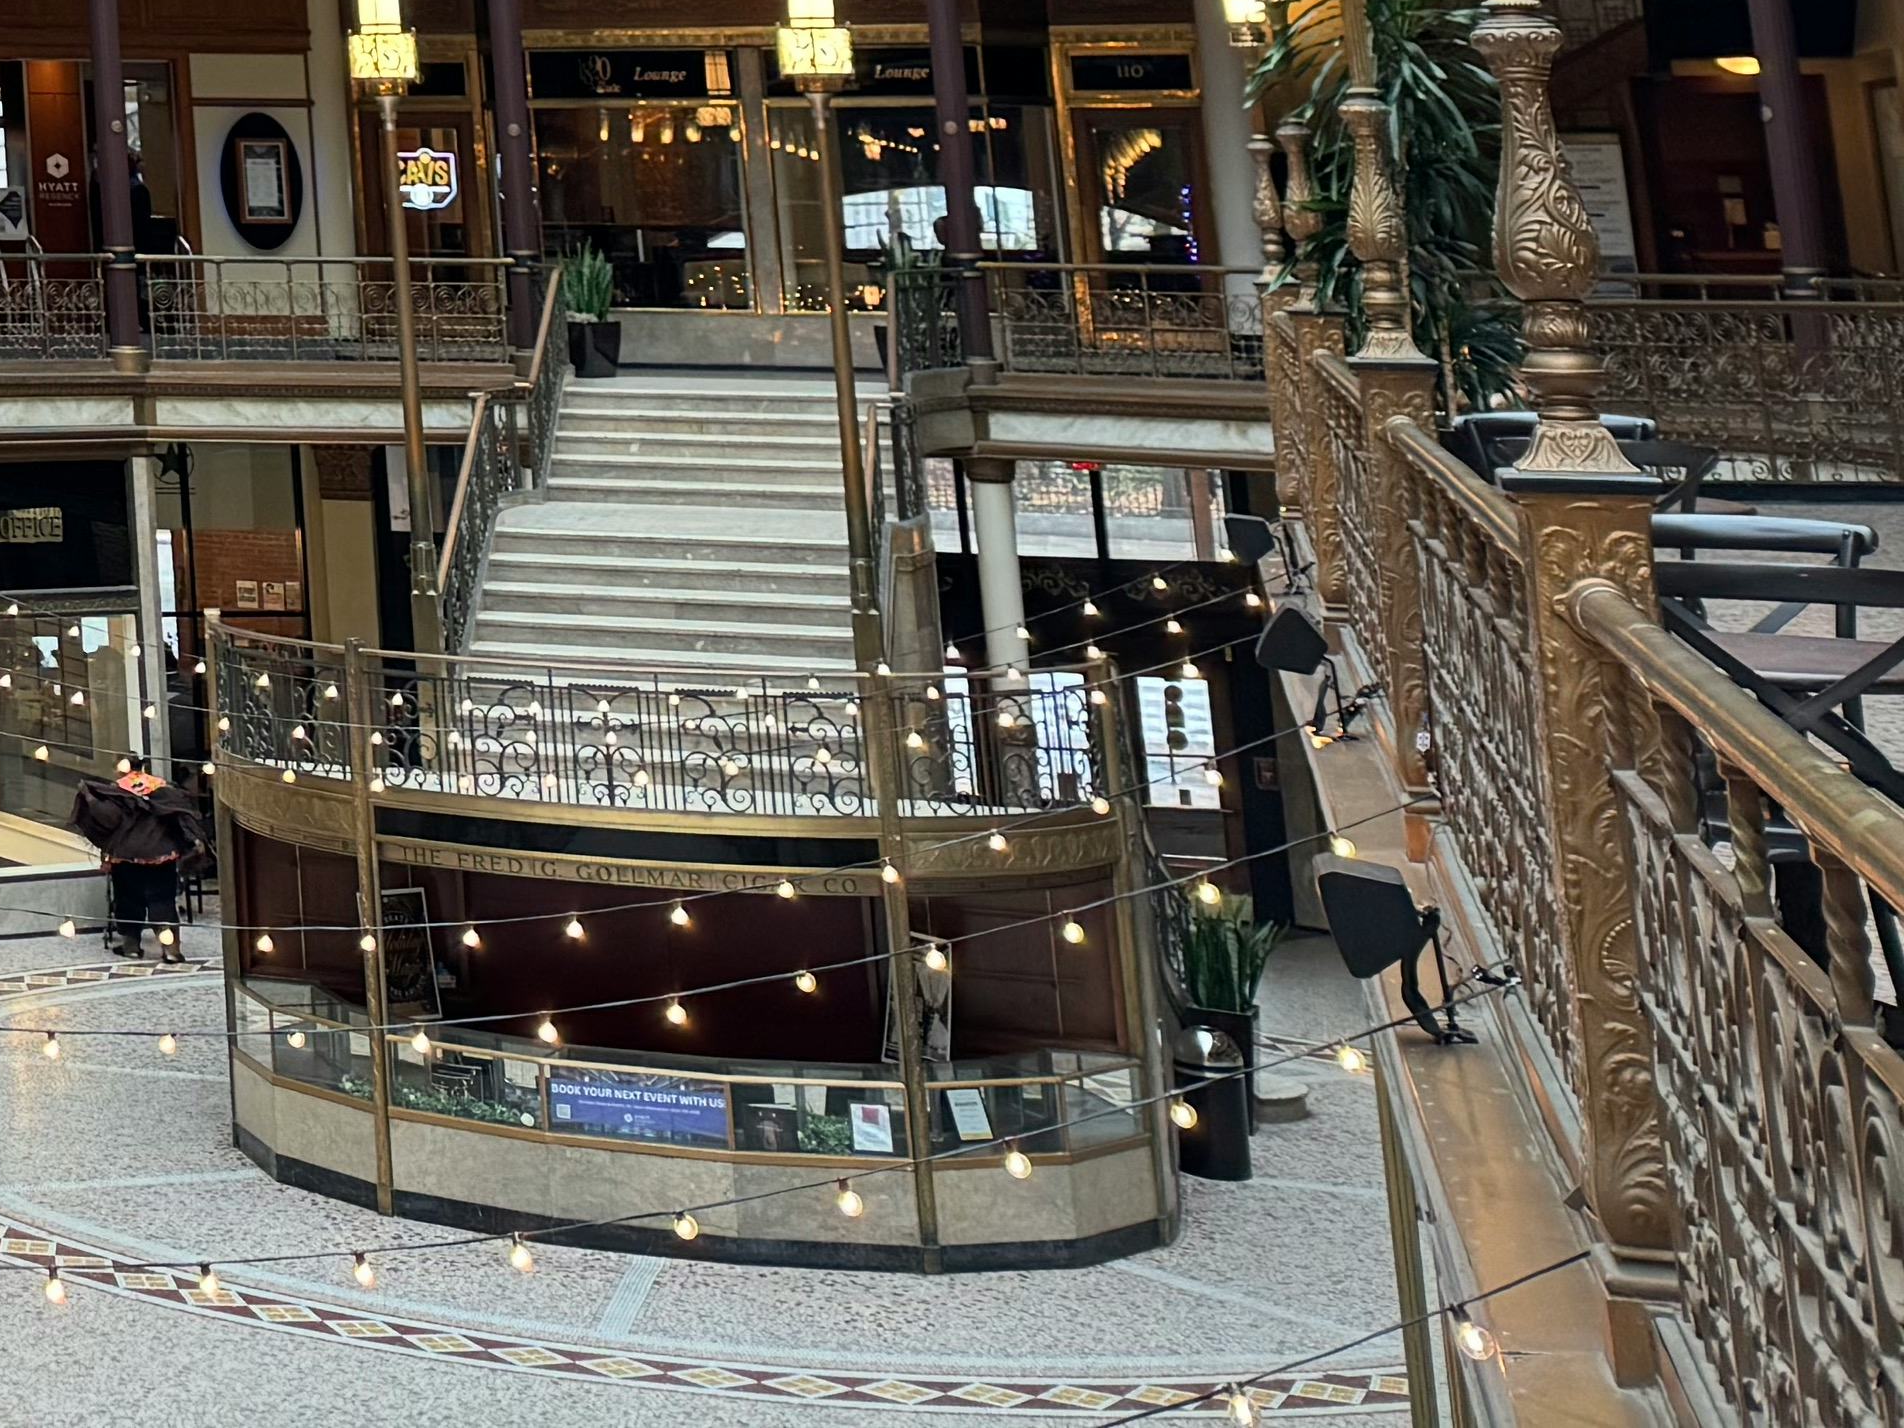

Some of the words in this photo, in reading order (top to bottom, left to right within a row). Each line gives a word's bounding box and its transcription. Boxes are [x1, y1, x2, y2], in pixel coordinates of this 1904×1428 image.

[633, 66, 687, 83] Lounge
[874, 64, 930, 80] Lounge
[38, 182, 79, 192] HYATT
[0, 516, 61, 540] OFFICE
[401, 847, 442, 866] THE
[456, 852, 524, 874] FRED
[541, 861, 564, 877] G.
[576, 863, 705, 890] GOLLMAR
[551, 1083, 582, 1096] BOOK
[583, 1086, 614, 1099] YOUR
[614, 1090, 642, 1102] NEXT
[643, 1093, 678, 1105] EVENT
[679, 1095, 708, 1108] WITH
